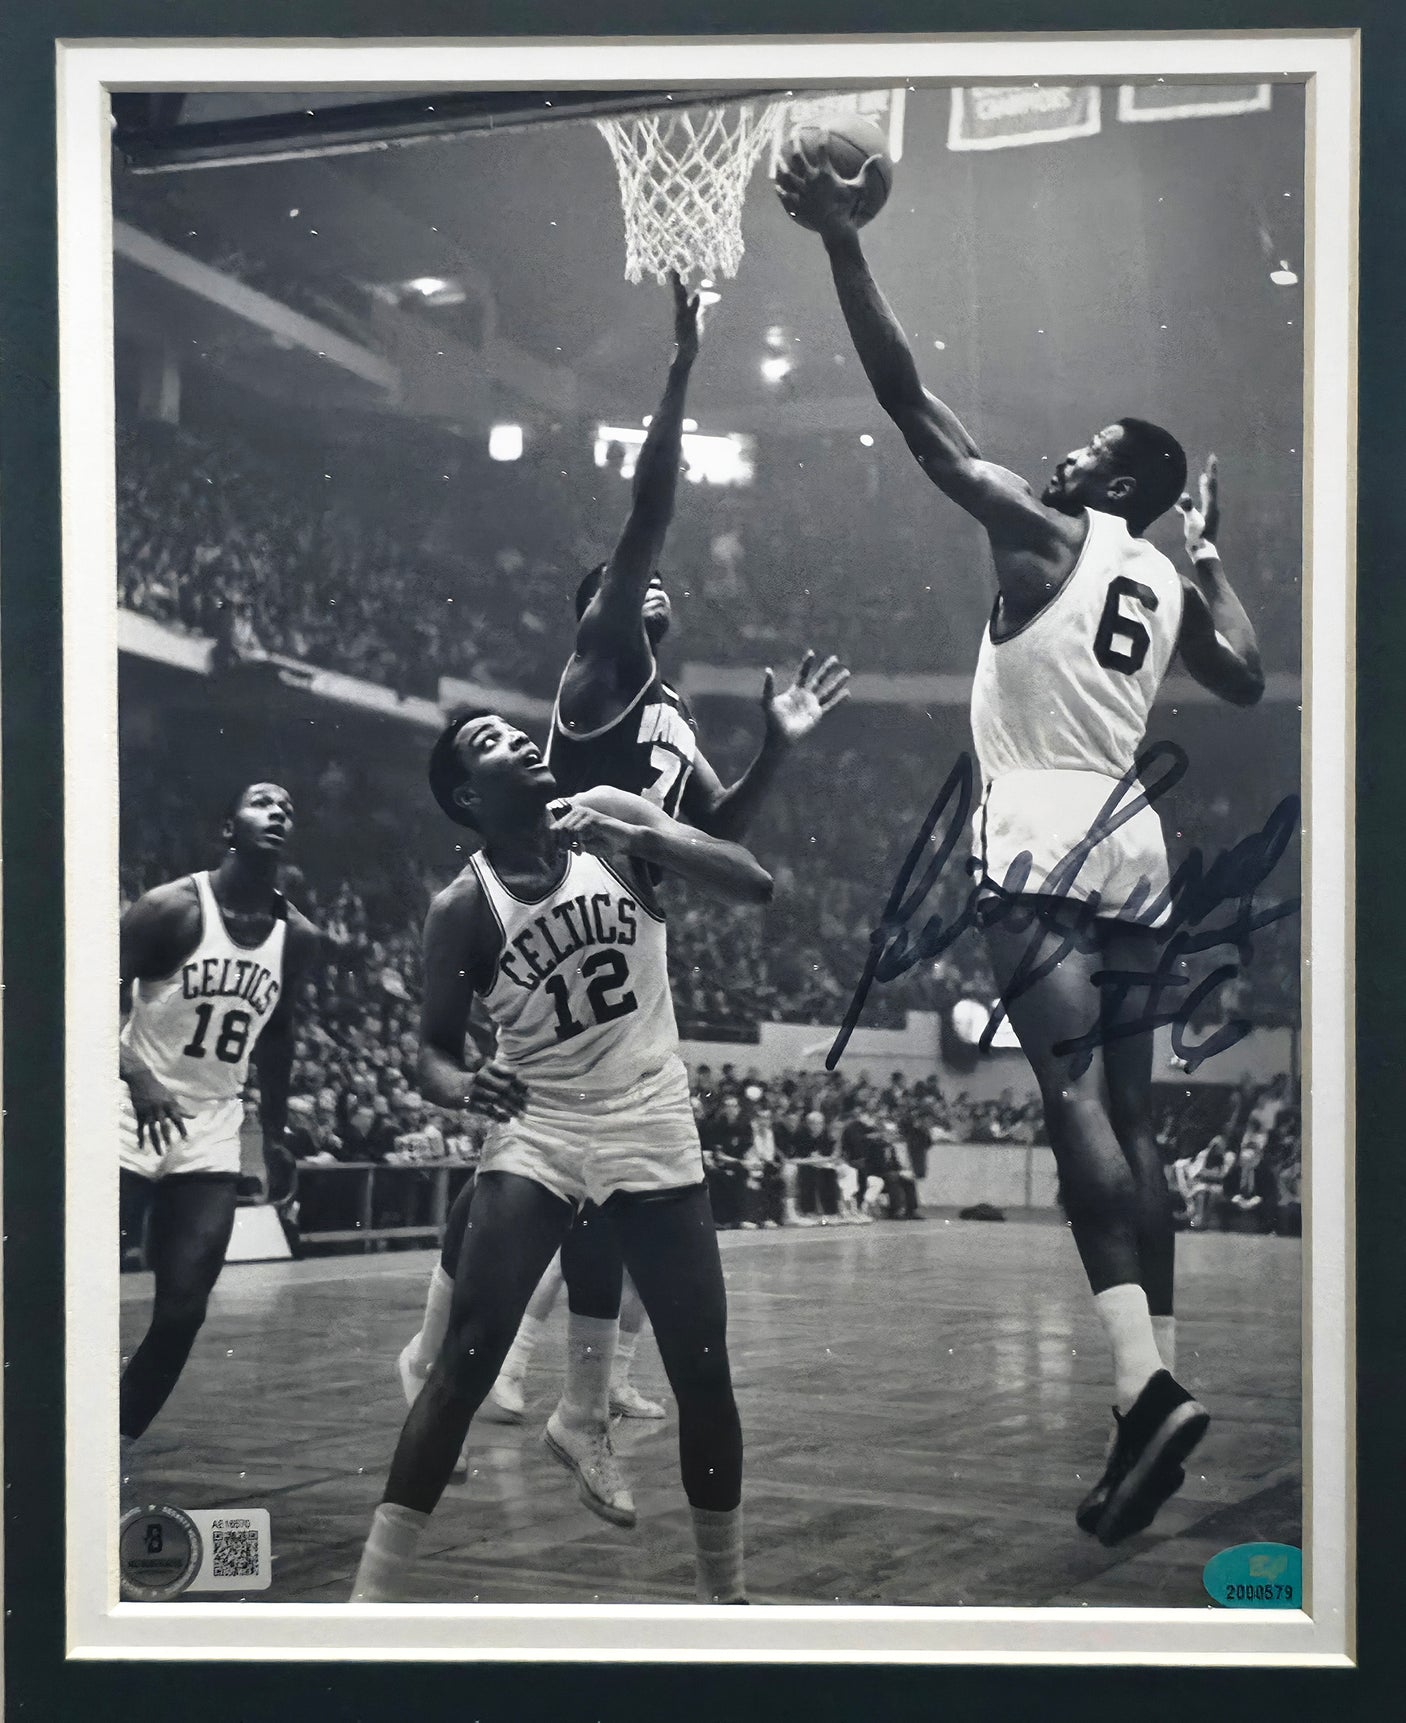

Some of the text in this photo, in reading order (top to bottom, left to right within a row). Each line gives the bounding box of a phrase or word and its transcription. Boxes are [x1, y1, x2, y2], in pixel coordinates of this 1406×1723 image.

[1093, 575, 1159, 676] 6
[500, 893, 637, 991] CELTICS
[183, 958, 279, 1016] CELTICS
[545, 948, 639, 1040] 12
[183, 1002, 252, 1064] 18
[1226, 1584, 1294, 1601] 2000579
